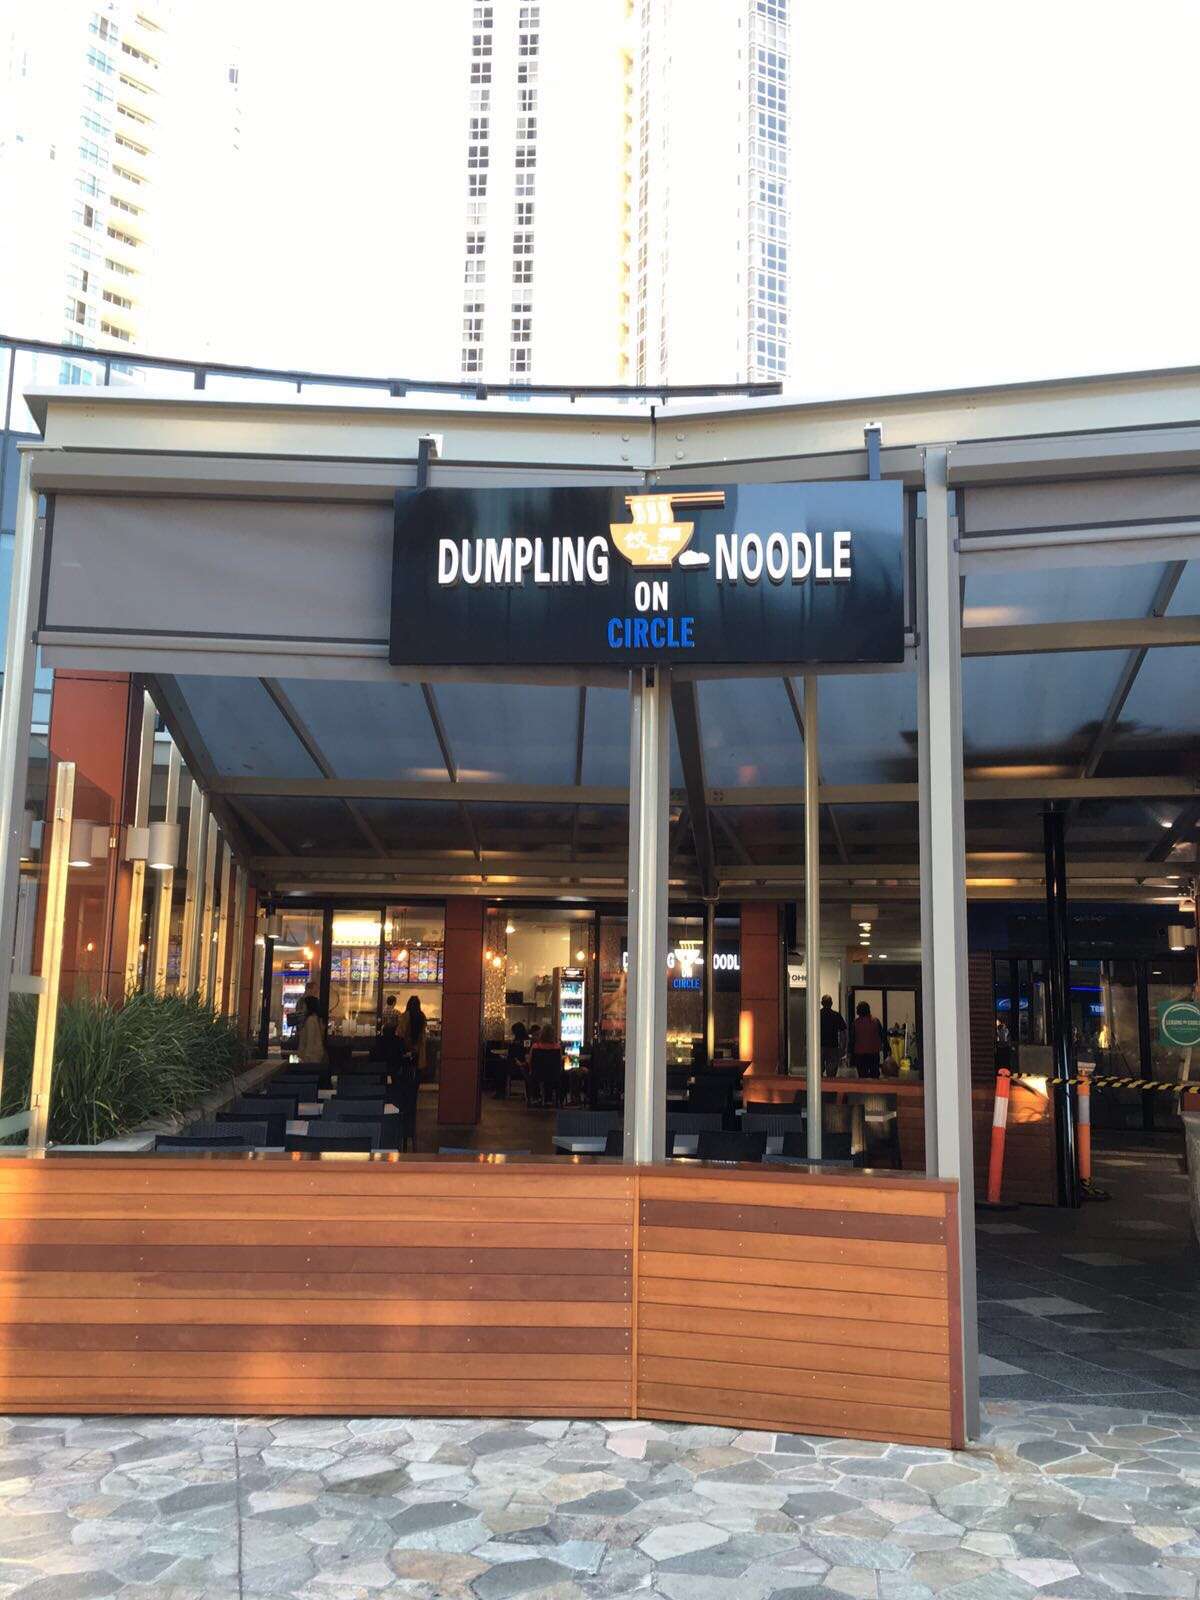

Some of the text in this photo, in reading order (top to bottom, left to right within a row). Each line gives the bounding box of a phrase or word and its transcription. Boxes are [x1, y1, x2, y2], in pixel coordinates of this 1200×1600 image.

[437, 530, 852, 585] DUMPLING NOODLE
[635, 581, 668, 611] ON
[607, 616, 695, 649] CIRCLE
[713, 954, 741, 970] OODL
[673, 979, 701, 989] CIRCLE
